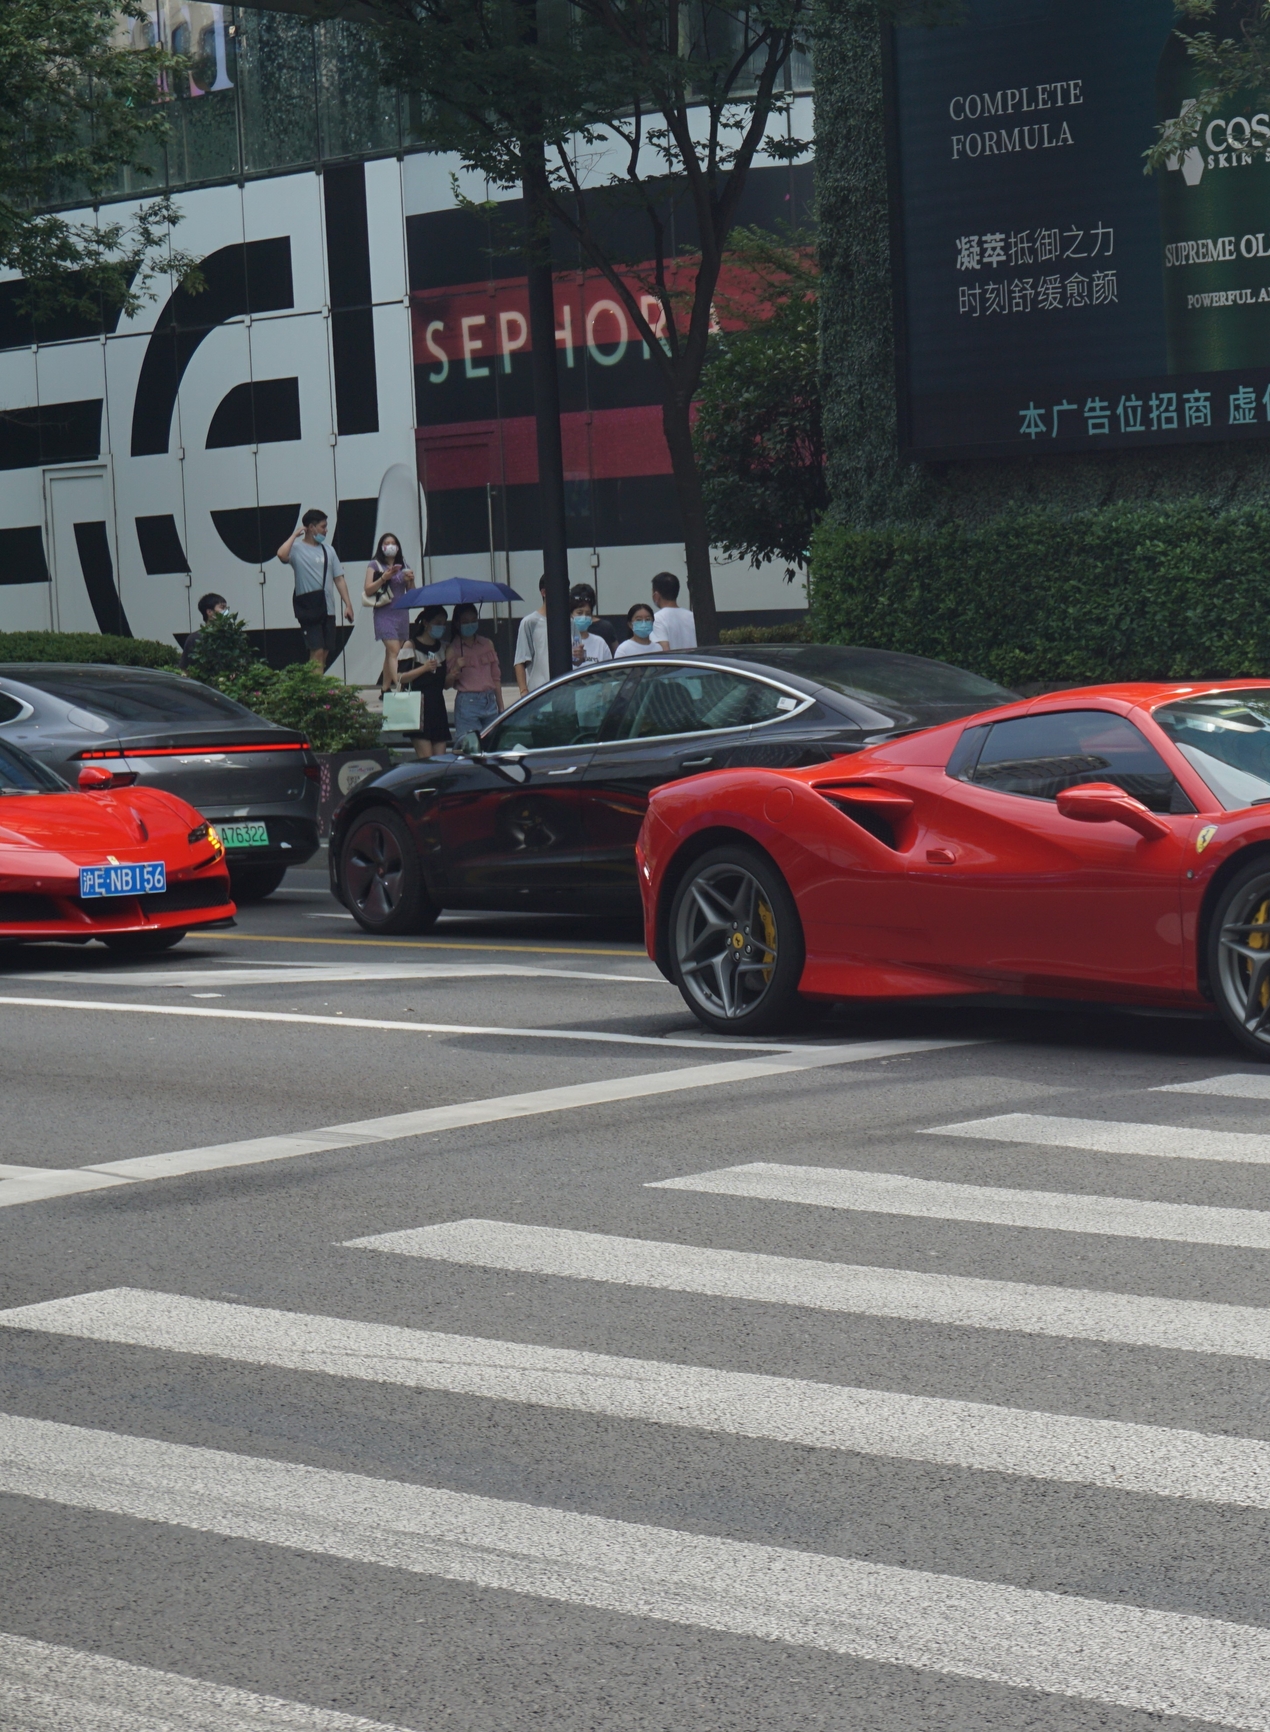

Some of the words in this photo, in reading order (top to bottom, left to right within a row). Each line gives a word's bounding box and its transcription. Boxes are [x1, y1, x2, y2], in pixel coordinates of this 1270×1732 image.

[949, 79, 1084, 121] COMPLETE
[951, 121, 1075, 160] FORMULA
[956, 221, 1114, 271] 凝萃抵御之力
[1165, 236, 1236, 267] SUPREME
[958, 269, 1119, 317] 时刻舒缓愈颜
[1187, 289, 1255, 309] POWERFUL
[426, 295, 722, 384] SEPHOR
[1018, 389, 1213, 440] 本广告位招商
